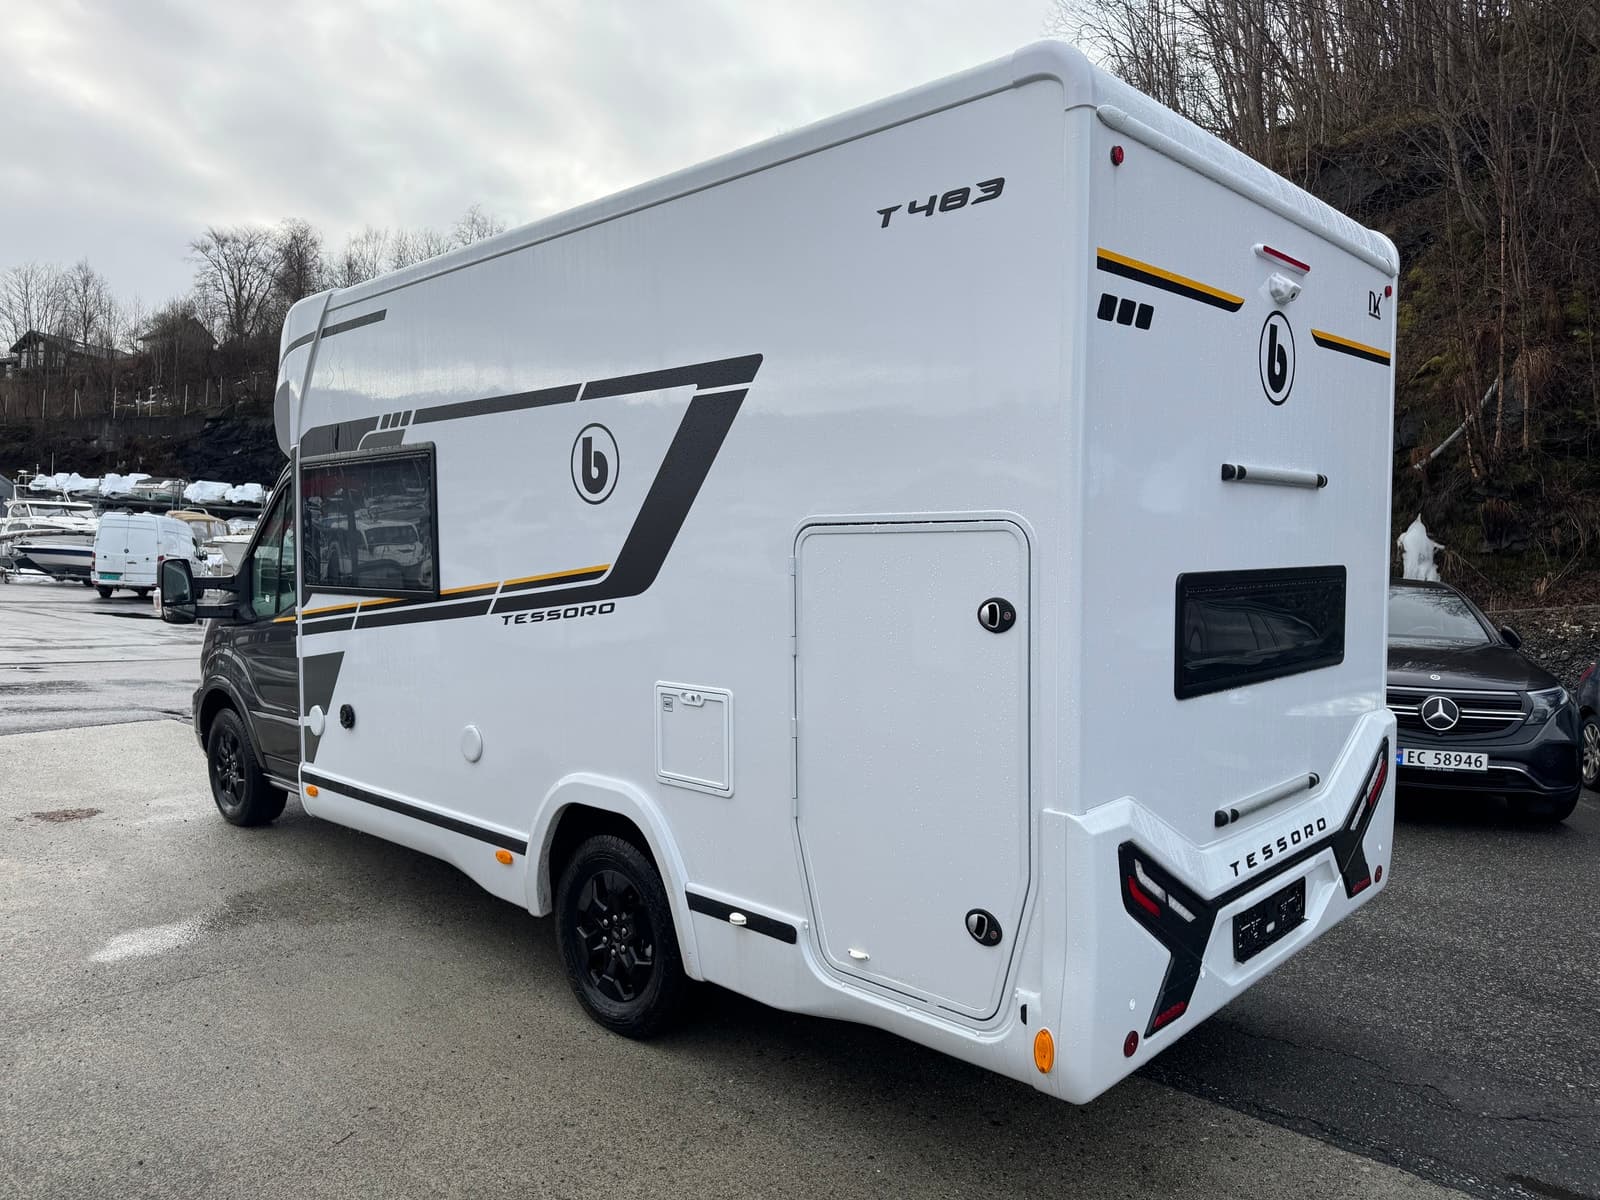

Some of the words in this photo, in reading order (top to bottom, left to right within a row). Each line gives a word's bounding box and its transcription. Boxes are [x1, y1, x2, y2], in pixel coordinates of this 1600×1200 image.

[1267, 323, 1288, 394] b
[581, 436, 609, 494] b
[501, 602, 615, 626] TESSORO
[1407, 750, 1426, 765] EC
[1433, 752, 1483, 769] 58946
[1229, 817, 1327, 877] TESSORO
